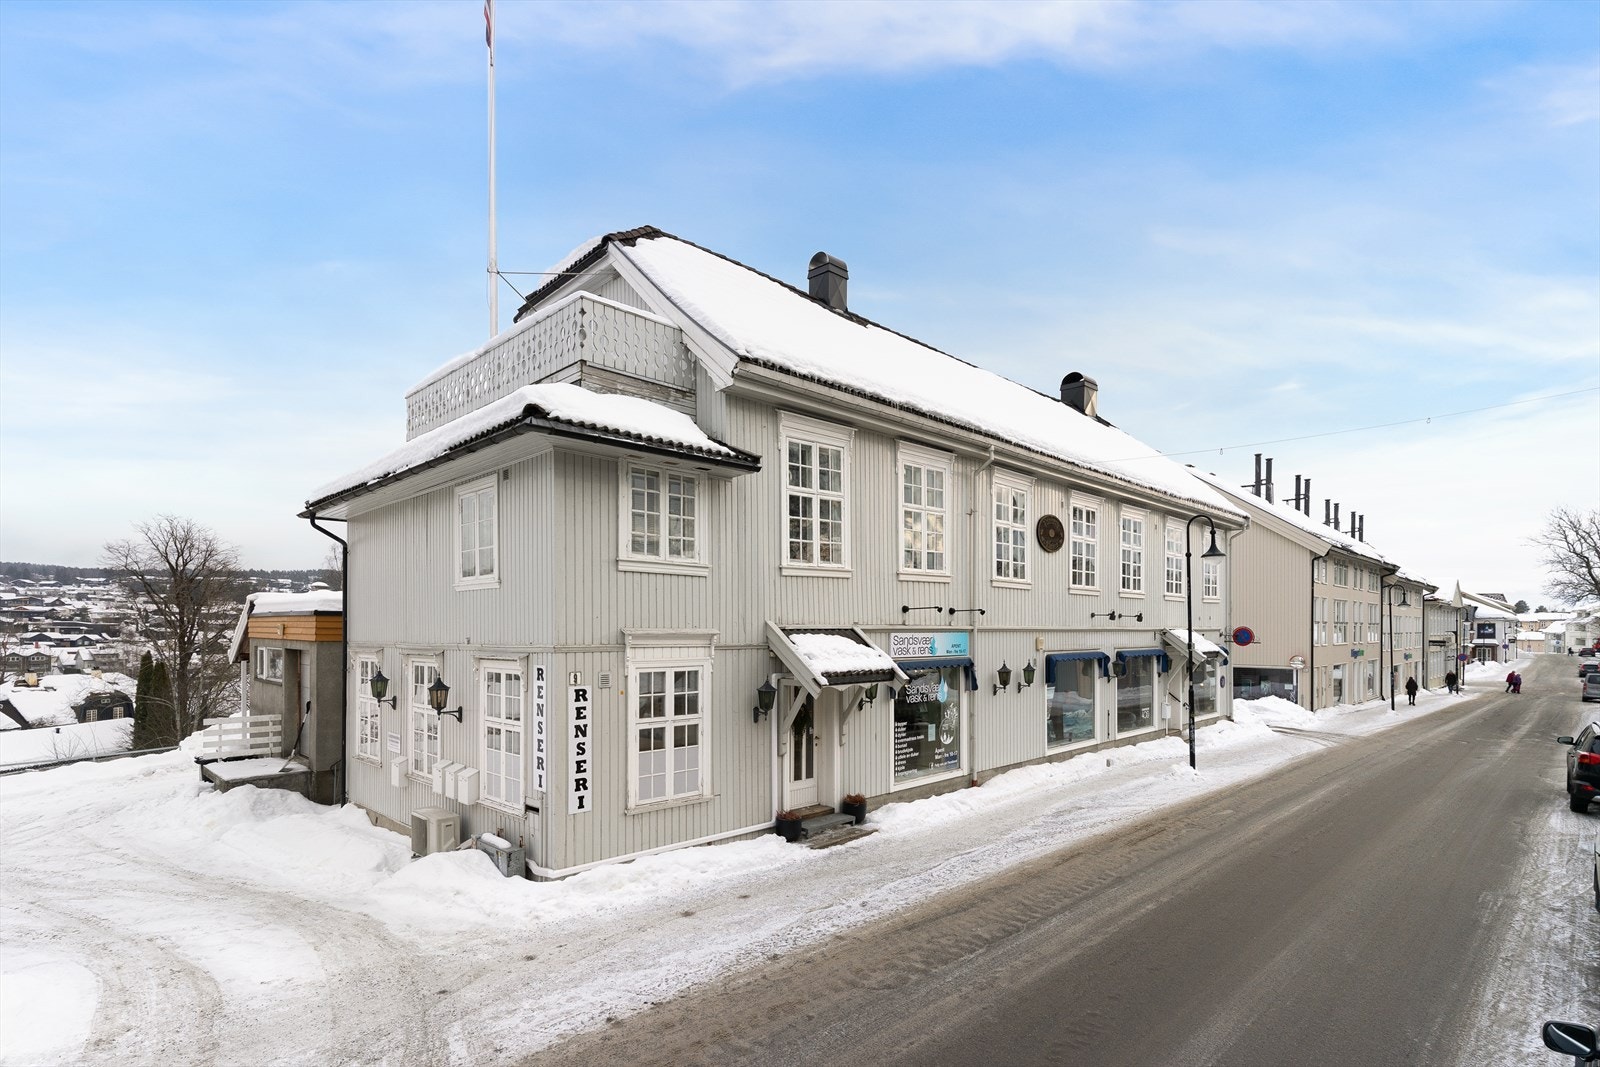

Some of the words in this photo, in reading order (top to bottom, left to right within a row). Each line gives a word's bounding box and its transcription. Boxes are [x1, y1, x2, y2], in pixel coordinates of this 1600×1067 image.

[893, 635, 934, 647] Sandsvær
[893, 646, 911, 656] vask
[912, 647, 917, 655] &
[918, 646, 934, 655] rens
[906, 694, 923, 703] vask
[536, 667, 545, 788] RENSERI
[574, 688, 588, 810] RENSERI
